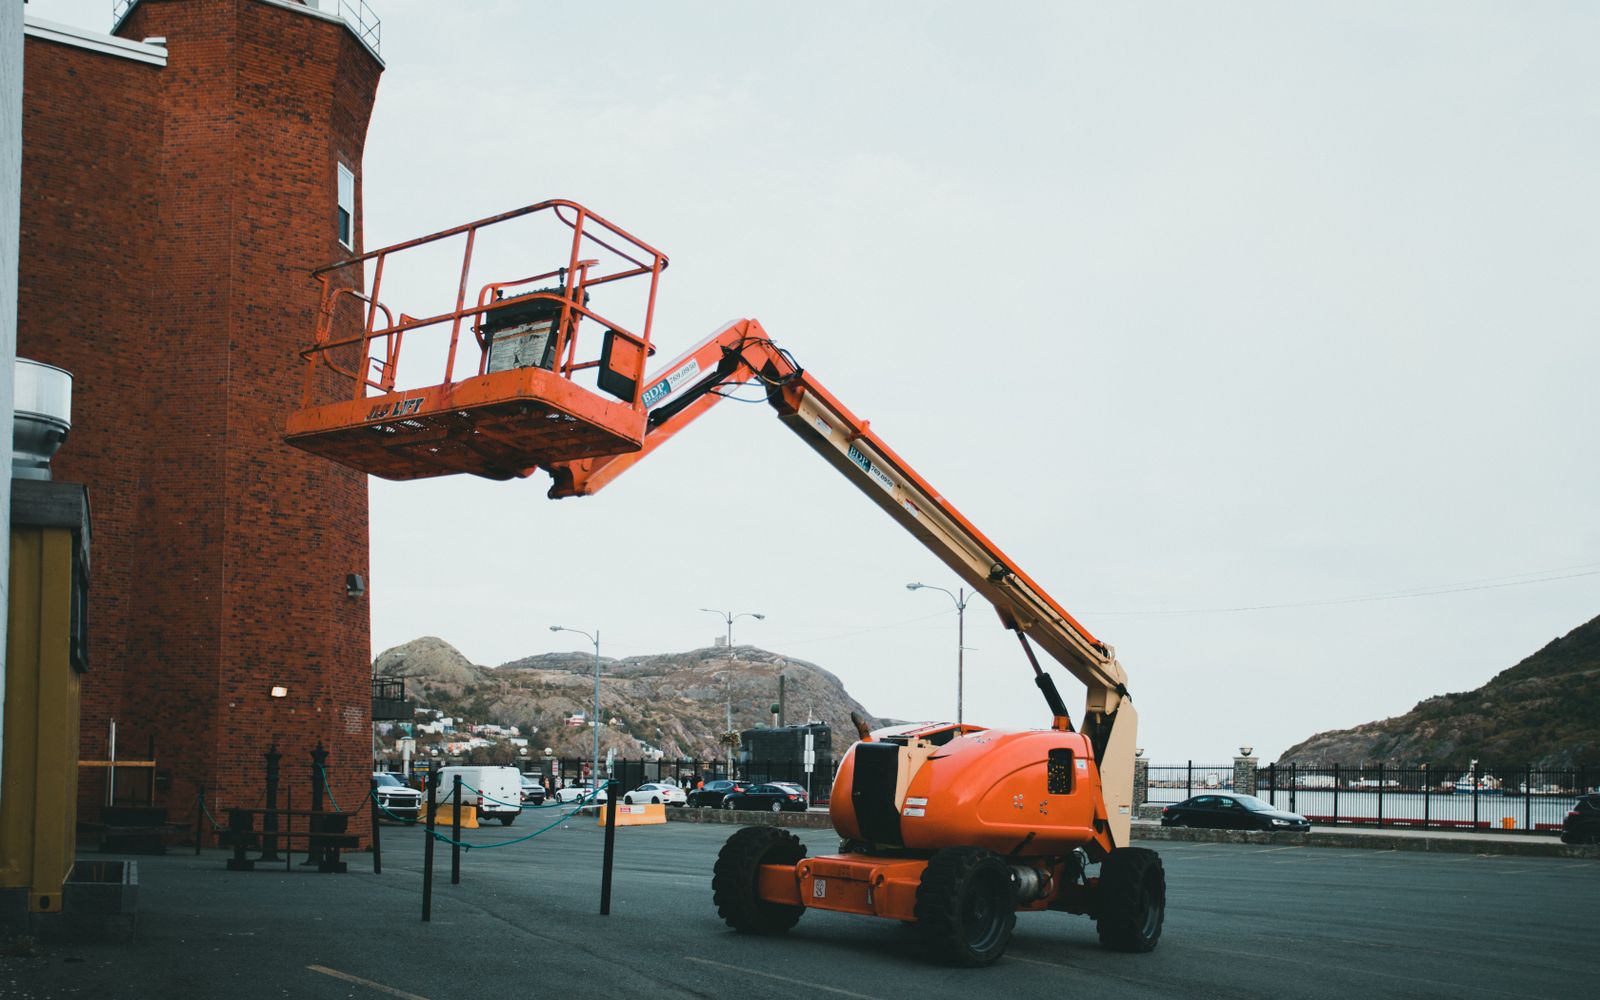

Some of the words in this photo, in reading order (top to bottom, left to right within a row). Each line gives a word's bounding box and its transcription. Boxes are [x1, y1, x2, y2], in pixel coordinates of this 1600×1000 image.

[642, 382, 665, 402] BDP
[392, 397, 425, 416] LIFT
[850, 446, 868, 464] BDP
